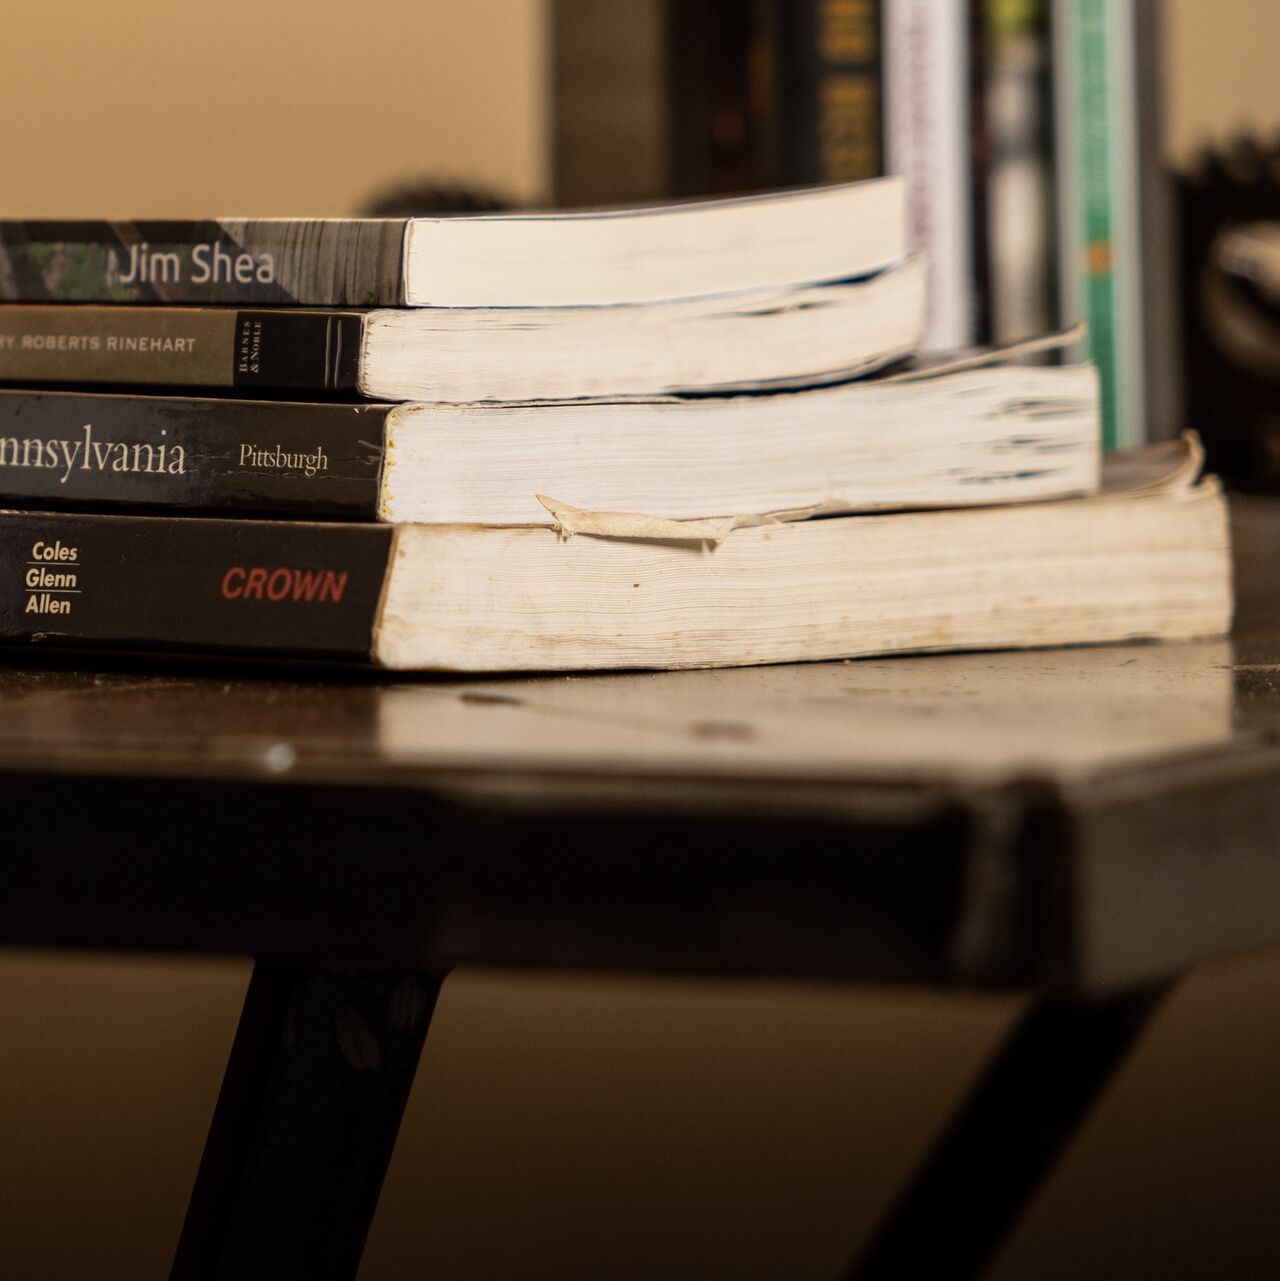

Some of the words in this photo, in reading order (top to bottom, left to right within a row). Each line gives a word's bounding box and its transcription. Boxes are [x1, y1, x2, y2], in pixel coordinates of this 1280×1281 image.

[119, 242, 180, 283] Jim
[191, 240, 274, 283] Shea
[21, 335, 100, 350] ROBERTS
[107, 336, 196, 352] RINEHART
[239, 443, 328, 477] Pittsburgh
[32, 541, 78, 561] Coles
[26, 567, 77, 587] Glenn
[221, 568, 349, 603] CROWN
[25, 593, 71, 614] Allen
